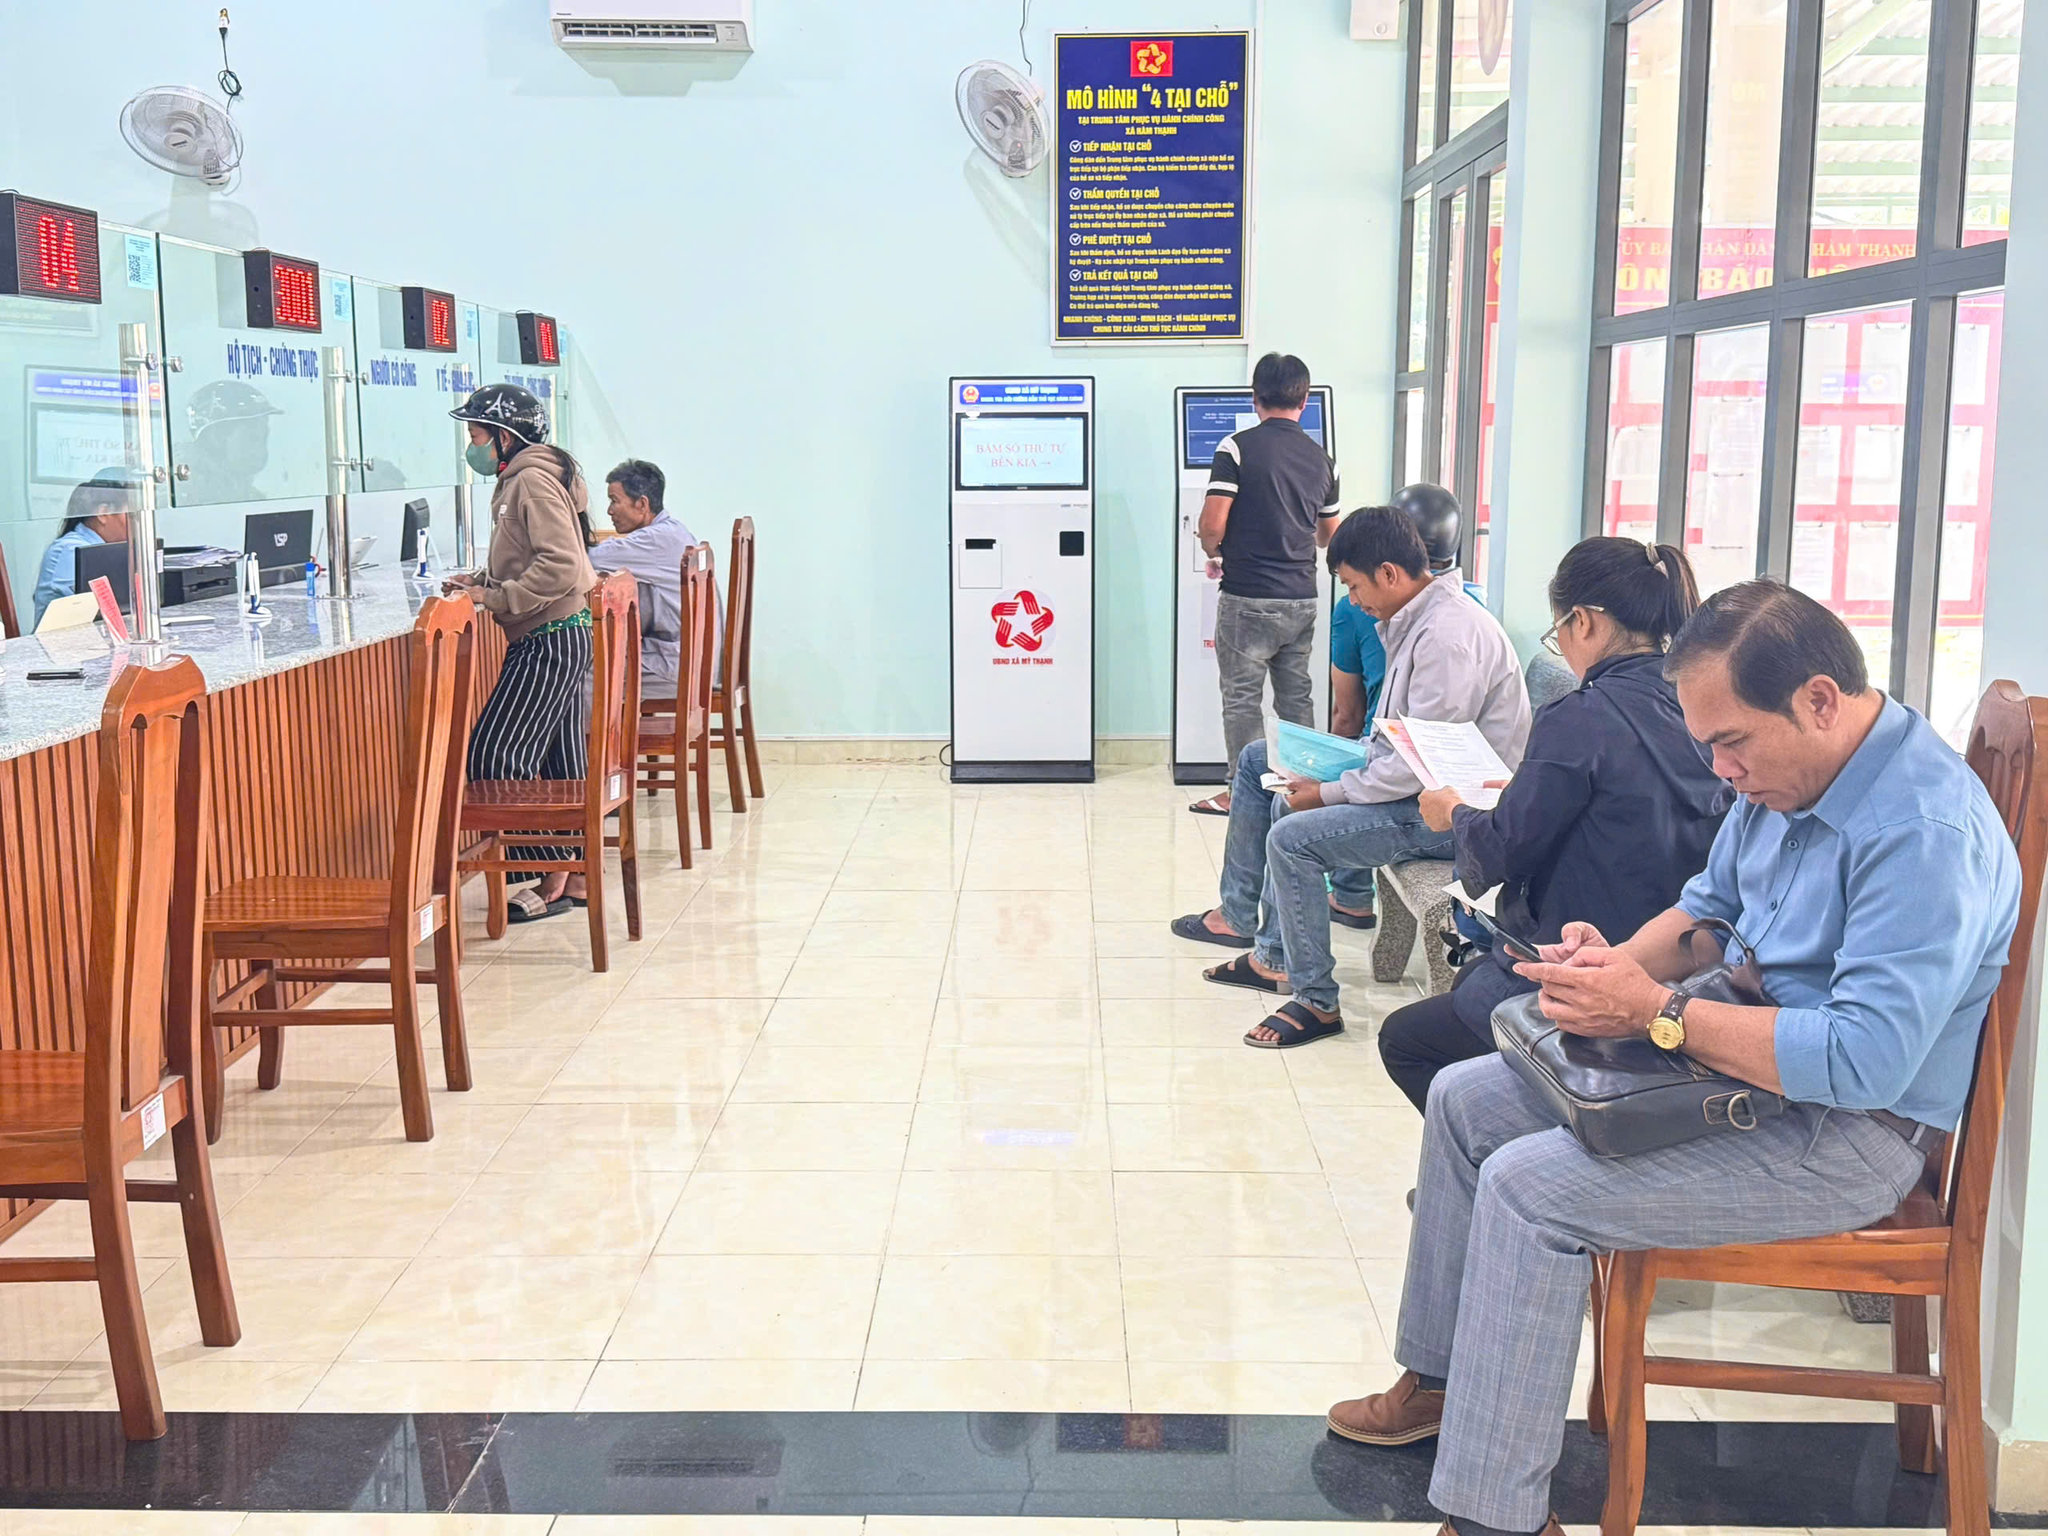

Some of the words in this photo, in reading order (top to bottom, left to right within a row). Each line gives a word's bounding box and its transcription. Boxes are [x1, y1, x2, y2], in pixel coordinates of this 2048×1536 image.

[1066, 85, 1093, 110] MÔ
[1097, 85, 1138, 109] HÌNH
[1165, 88, 1191, 112] TẠI
[1702, 238, 1740, 256] HÂN
[1744, 238, 1774, 256] DÂ
[227, 338, 241, 379] HỘ
[242, 343, 263, 379] TỊCH
[269, 342, 298, 377] CHỨNG
[298, 347, 319, 383] THỰC
[1017, 458, 1037, 468] KIA
